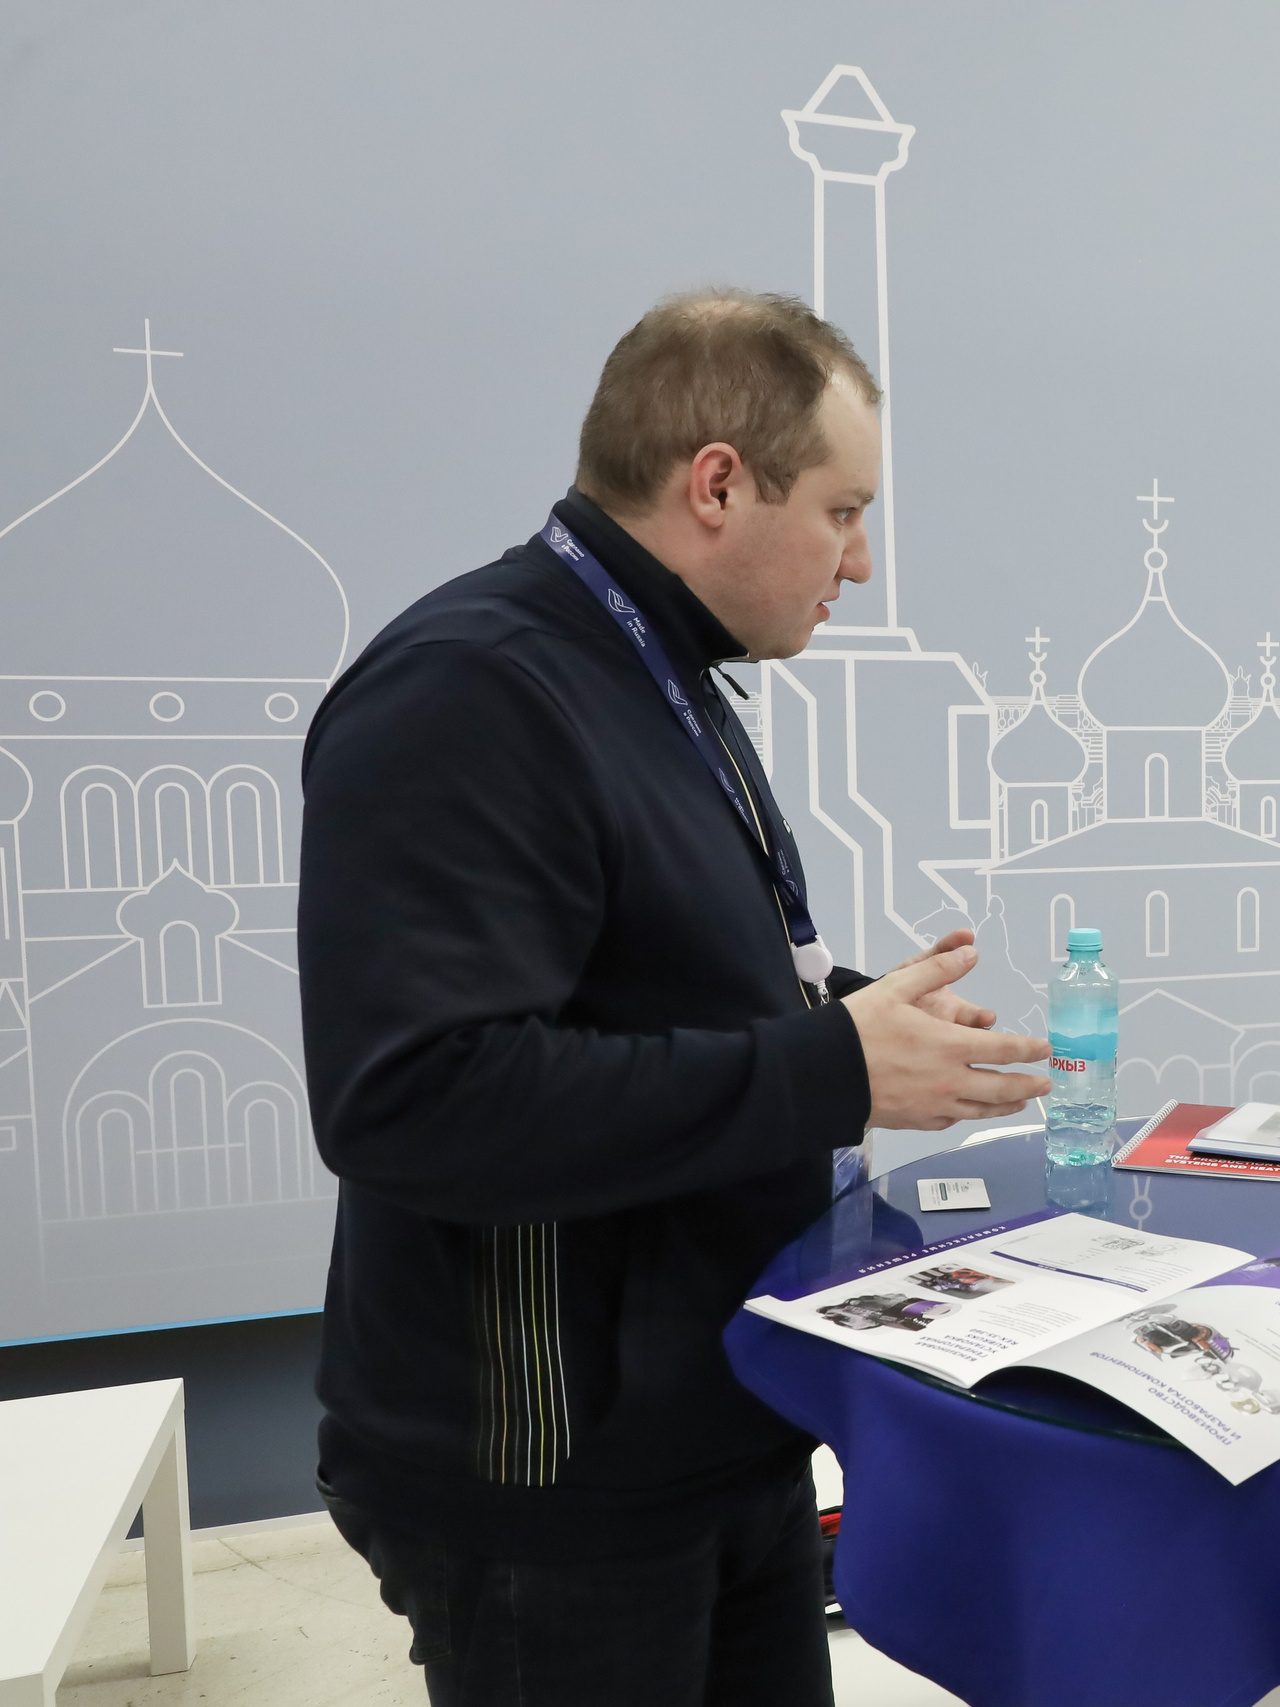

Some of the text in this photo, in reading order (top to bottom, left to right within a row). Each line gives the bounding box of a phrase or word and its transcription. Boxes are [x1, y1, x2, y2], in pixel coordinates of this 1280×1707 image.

[627, 620, 646, 647] in Russia
[633, 617, 645, 634] Made
[1164, 1158, 1219, 1168] SYSTEMS
[858, 1252, 917, 1274] РЕШЕНИЯ
[1089, 1351, 1166, 1388] КОМПОНЕНТОВ
[1147, 1387, 1232, 1445] ПРОИЗВОДСТВО
[1166, 1387, 1231, 1433] РАЗРАБОТКА
